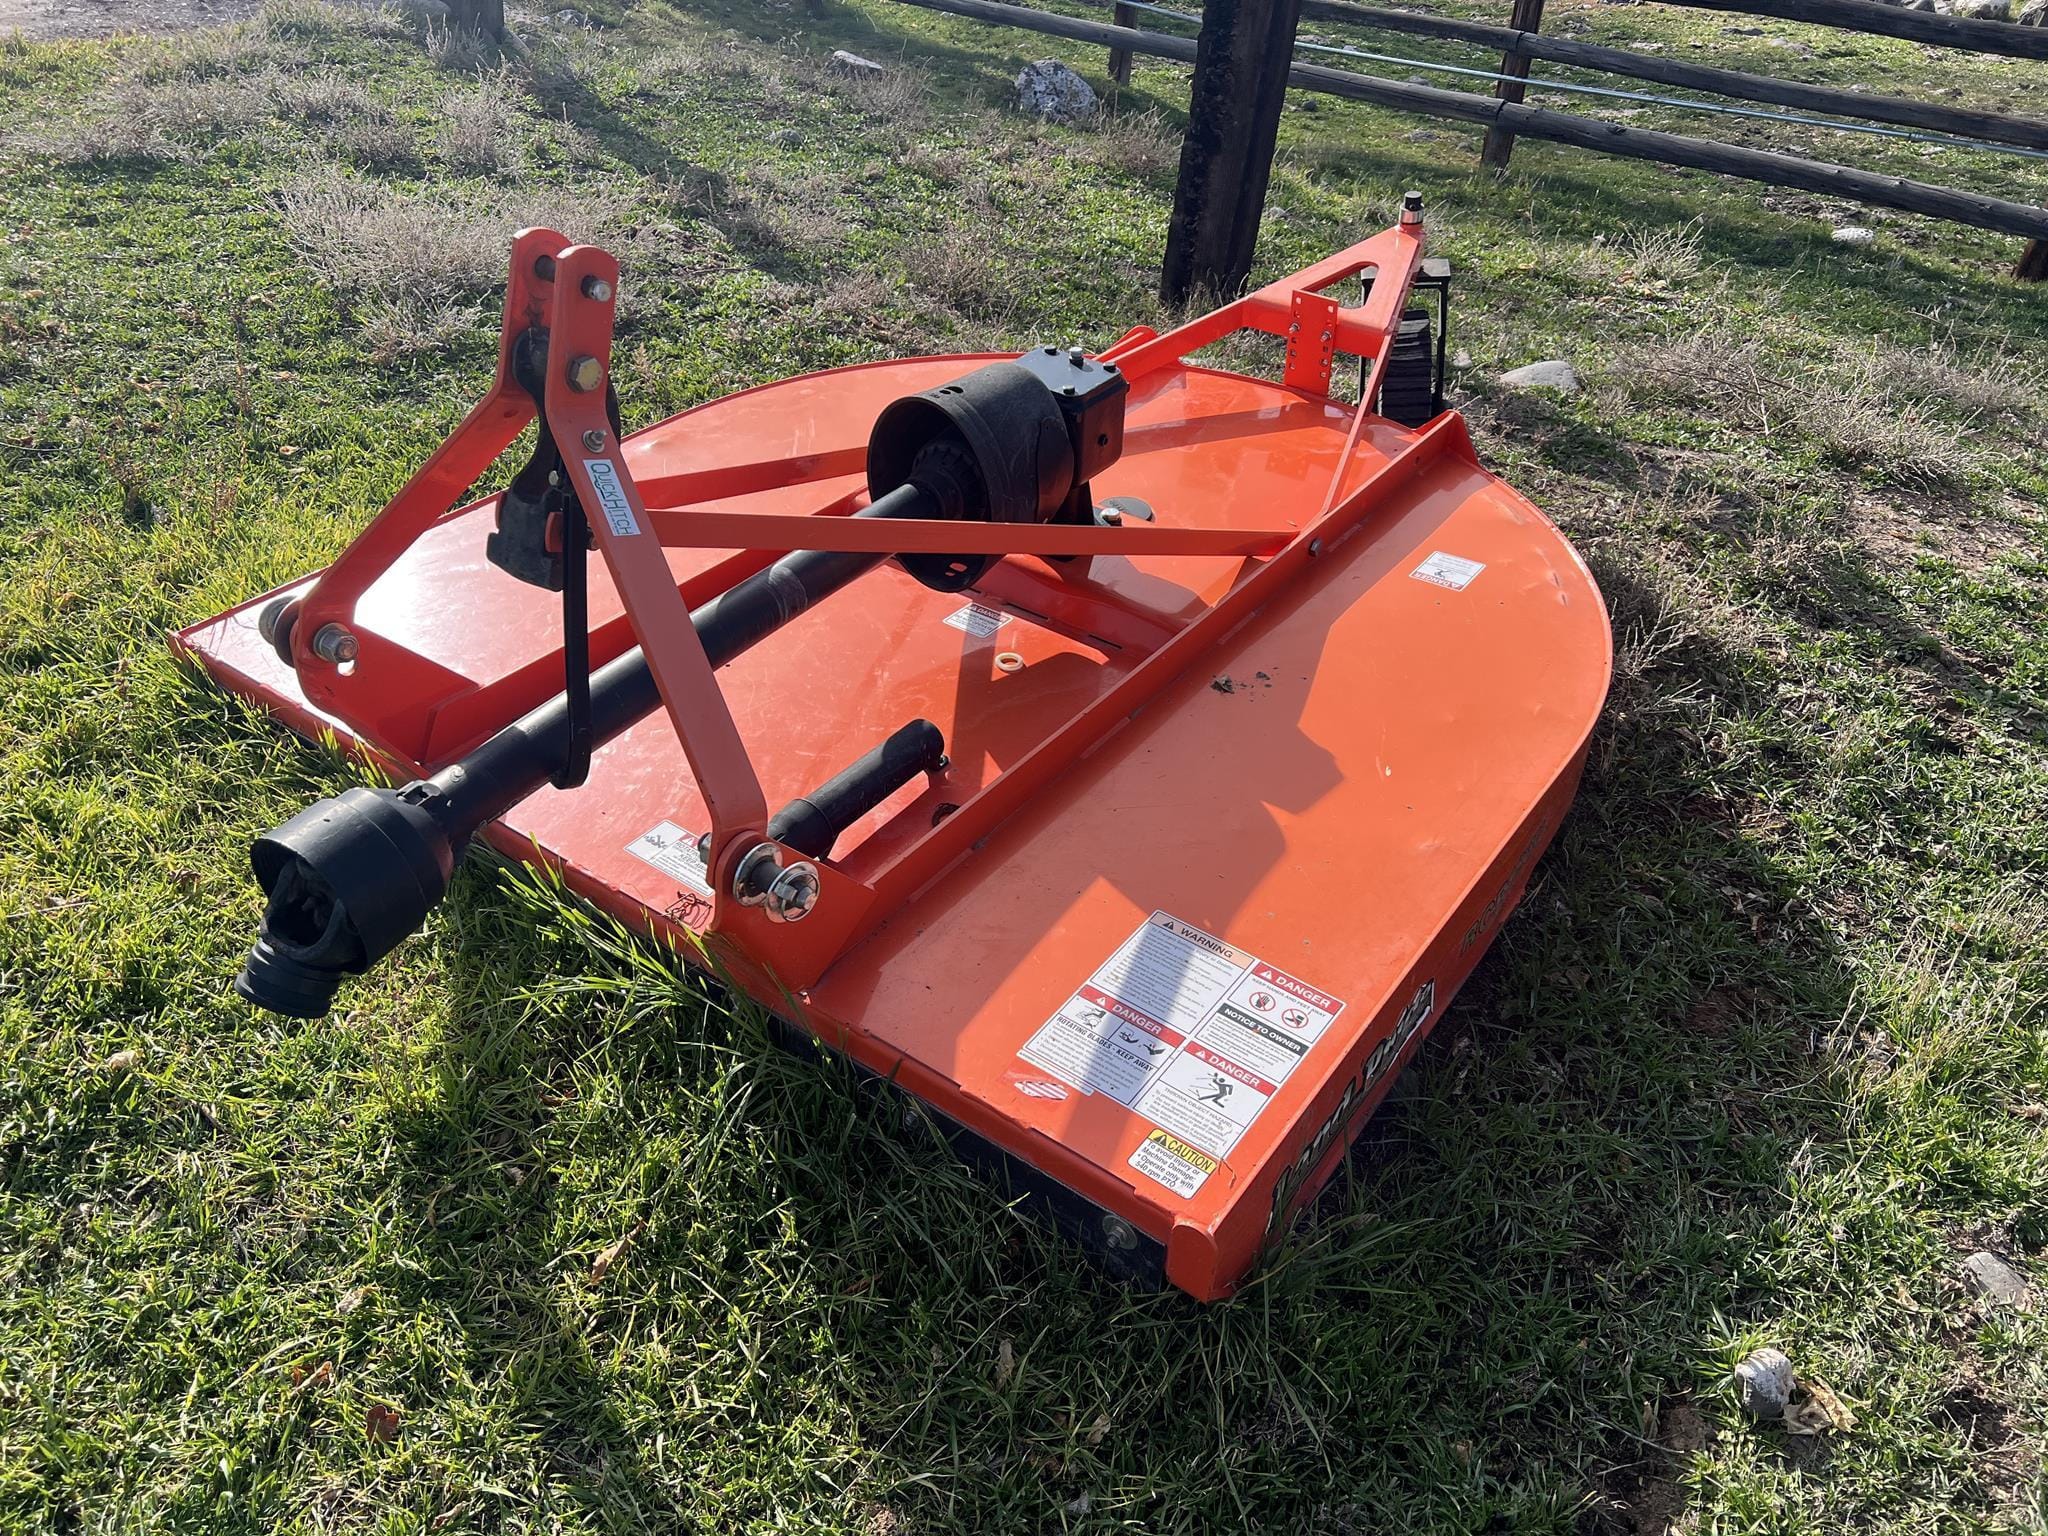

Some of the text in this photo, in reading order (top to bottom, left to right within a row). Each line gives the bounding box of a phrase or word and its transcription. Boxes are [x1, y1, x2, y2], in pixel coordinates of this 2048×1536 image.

[1180, 927, 1234, 959] WARNING
[1276, 975, 1331, 1008] DANGER
[1112, 1003, 1164, 1034] DANGER
[1224, 1007, 1302, 1052] NOTICE TO OWNER
[1056, 1015, 1088, 1036] ROTATING
[1087, 1032, 1114, 1049] BLADES
[1116, 1048, 1135, 1061] KEEP
[1133, 1057, 1154, 1072] AWAY
[1208, 1054, 1262, 1087] DANGER
[1163, 1087, 1189, 1103] THROWN
[1187, 1099, 1210, 1115] OBJECT
[1141, 1146, 1168, 1165] Machine
[1147, 1142, 1201, 1176] To avoid injury or
[1168, 1140, 1213, 1171] CAUTION
[1135, 1160, 1176, 1188] 540 rpm PTO
[1141, 1154, 1195, 1190] Operate only with
